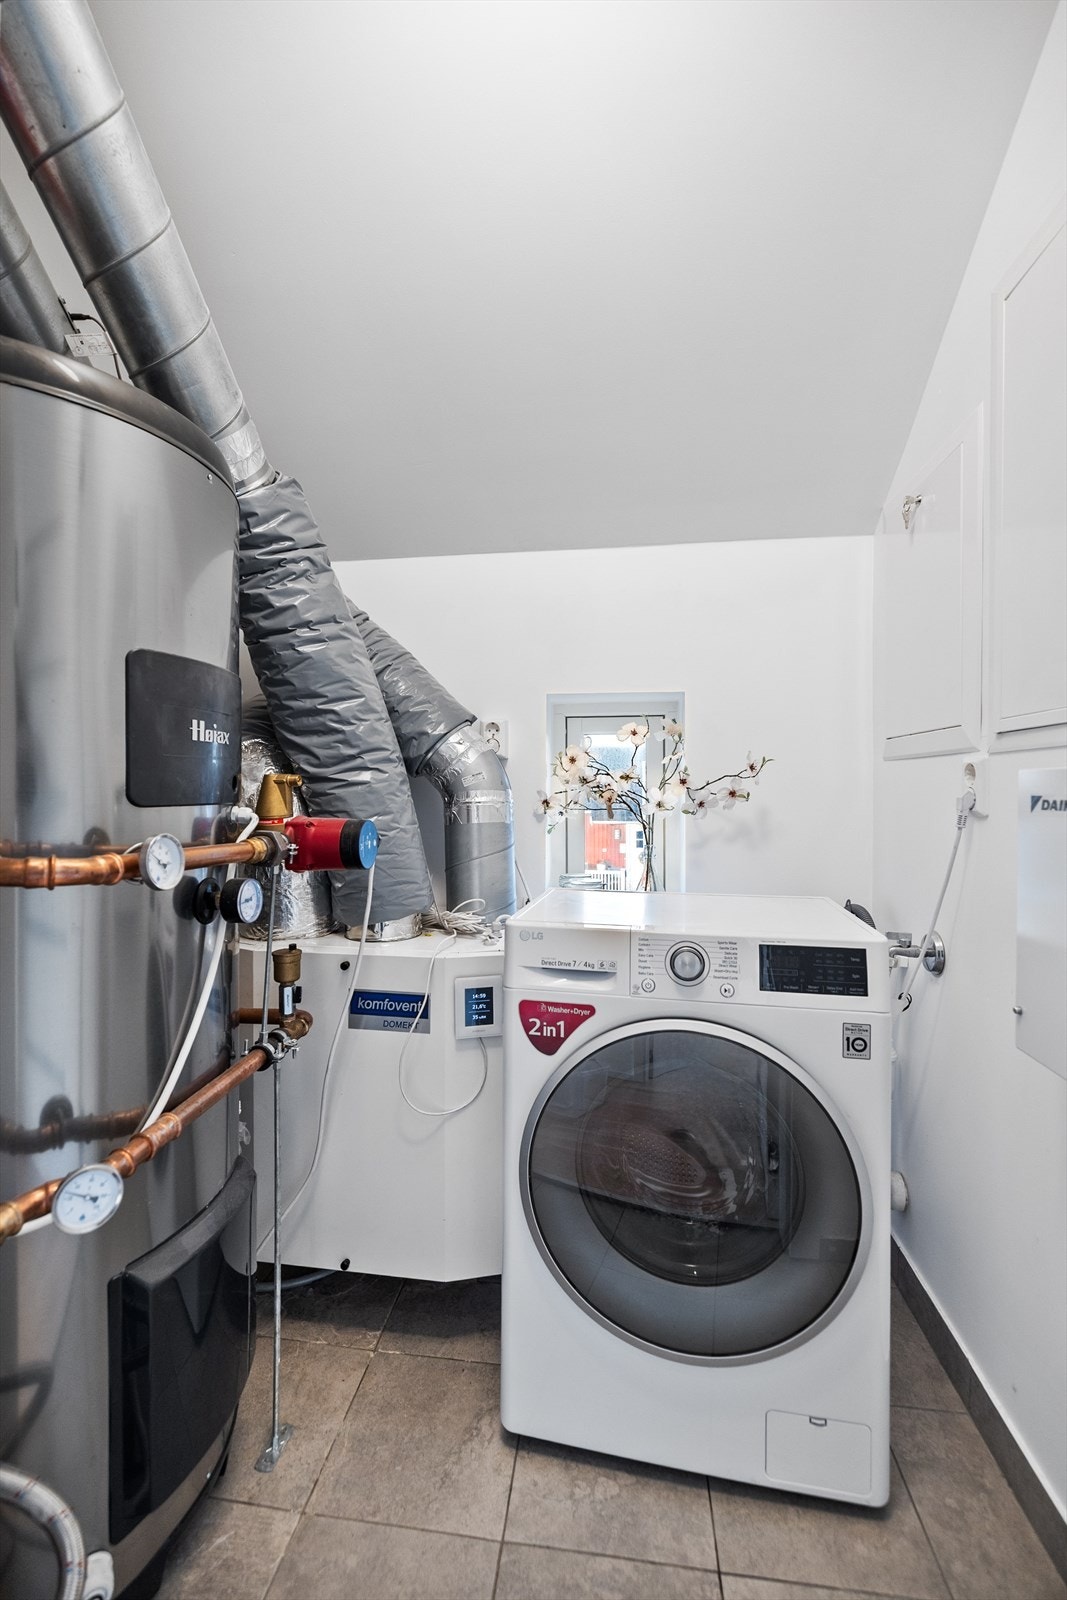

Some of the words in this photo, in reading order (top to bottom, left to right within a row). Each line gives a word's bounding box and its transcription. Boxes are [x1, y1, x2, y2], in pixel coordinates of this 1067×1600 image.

[531, 932, 544, 940] LG
[541, 959, 557, 967] Direct
[357, 997, 422, 1013] komfovent
[547, 1005, 591, 1016] Washer+Dryer
[845, 1036, 868, 1053] 10
